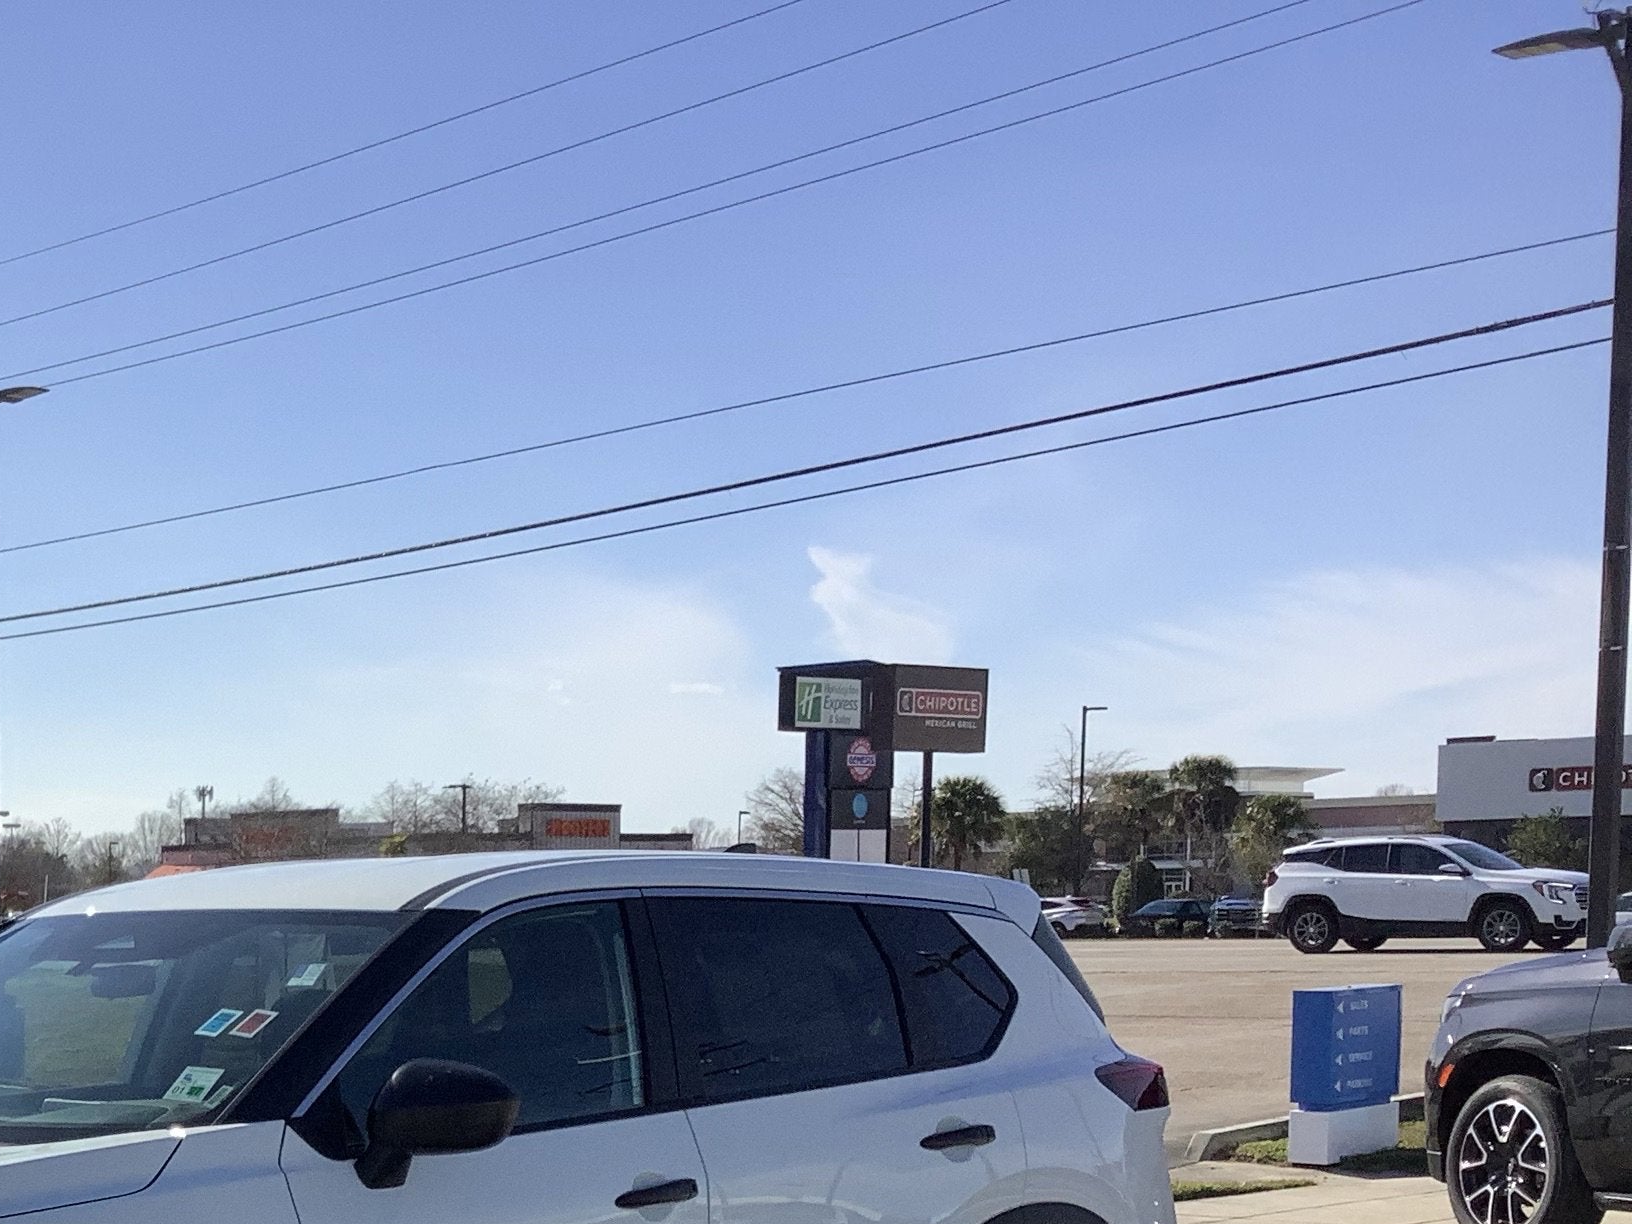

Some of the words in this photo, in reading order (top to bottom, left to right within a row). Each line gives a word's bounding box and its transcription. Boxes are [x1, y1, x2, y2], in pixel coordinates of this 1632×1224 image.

[823, 694, 859, 713] Express
[916, 695, 978, 712] CHIPOTLE
[925, 719, 956, 728] MEXICAN
